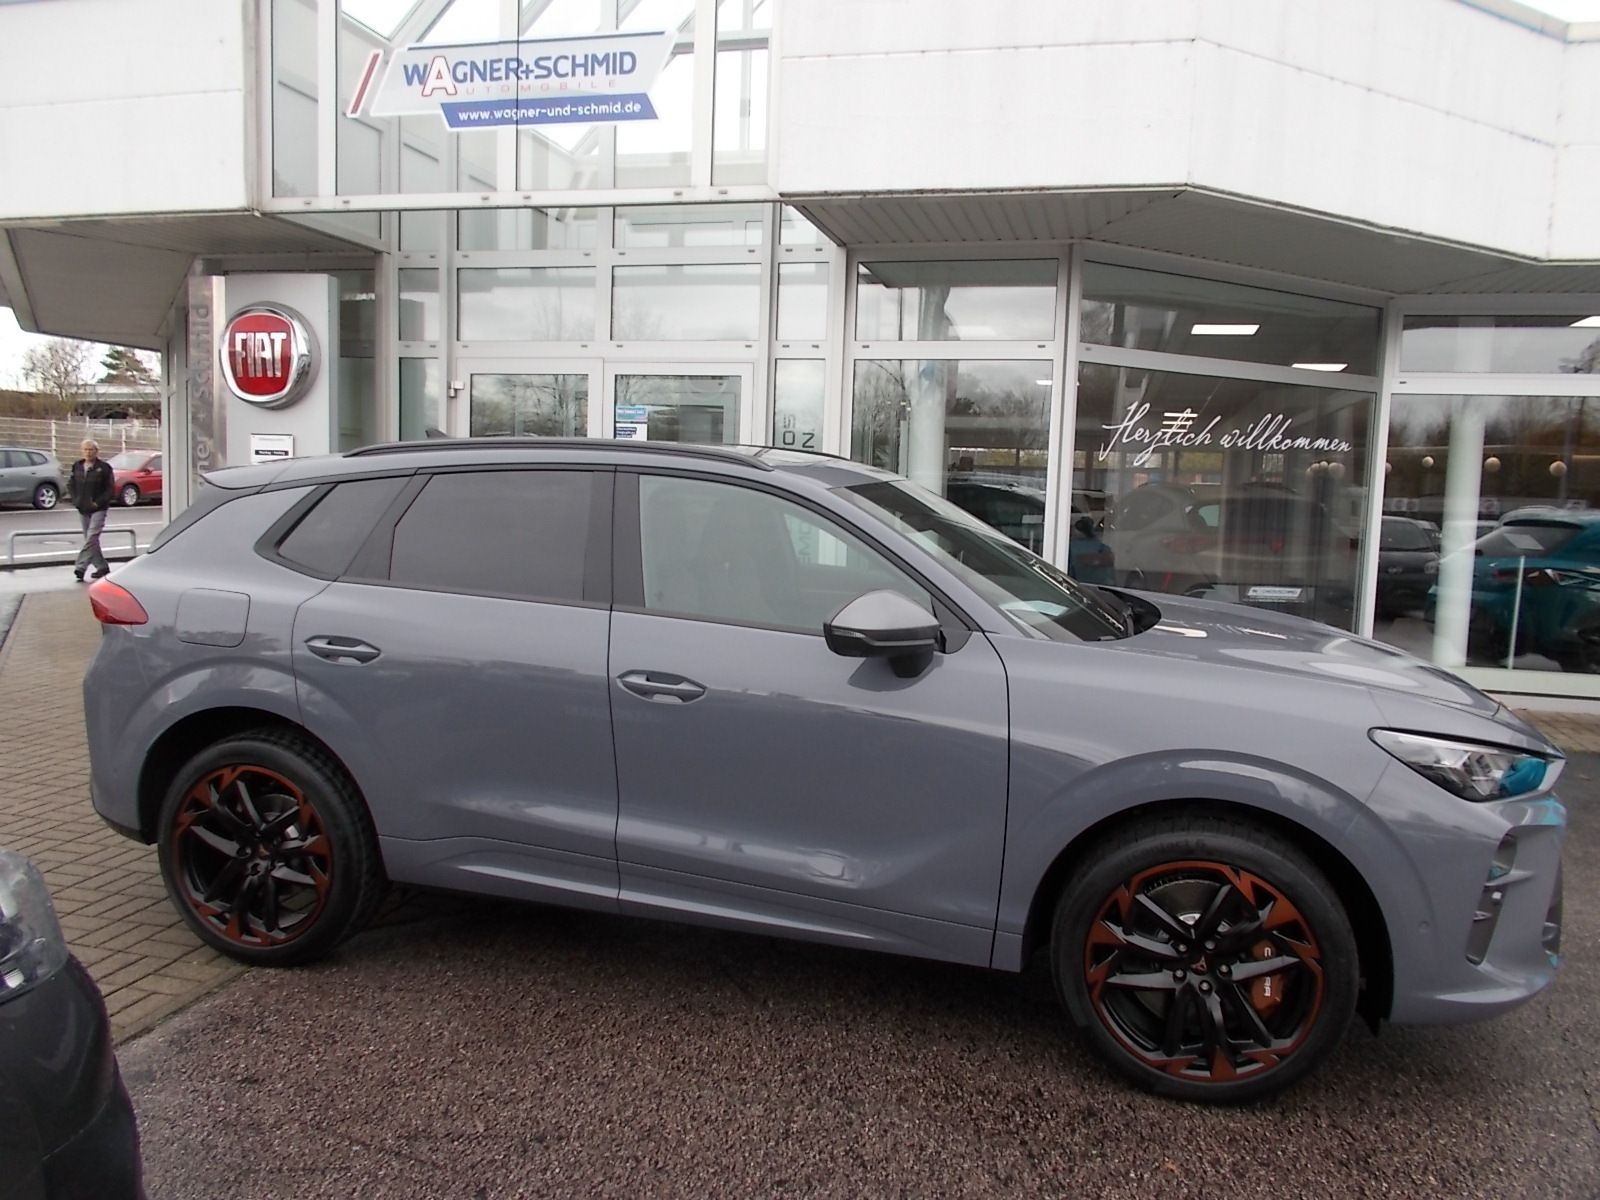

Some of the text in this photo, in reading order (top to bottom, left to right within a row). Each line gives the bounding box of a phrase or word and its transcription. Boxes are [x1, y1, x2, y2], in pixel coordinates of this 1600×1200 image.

[458, 101, 642, 121] www.wagner-und-schmid.de
[235, 332, 287, 378] FIAT
[1098, 401, 1353, 466] Herzlich willkommen
